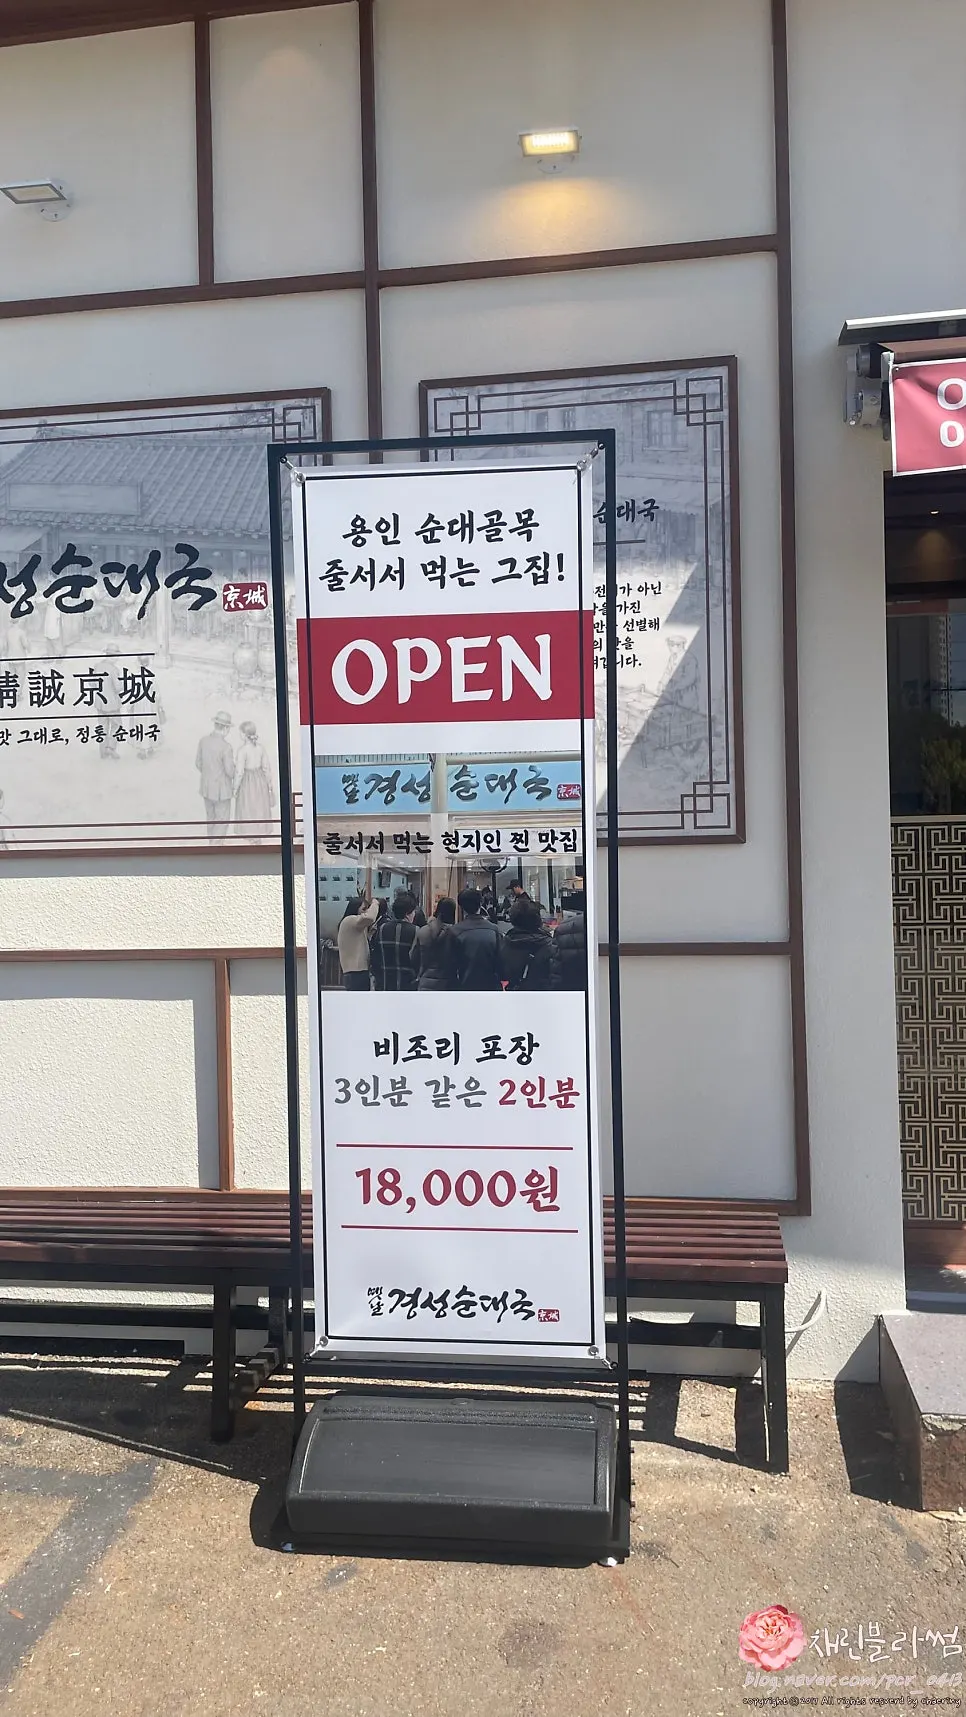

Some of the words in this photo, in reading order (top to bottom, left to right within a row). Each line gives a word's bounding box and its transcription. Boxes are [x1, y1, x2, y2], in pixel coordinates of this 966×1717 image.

[342, 512, 401, 548] 용인
[414, 508, 540, 543] 순대골목
[318, 556, 405, 592] 줄서서
[420, 555, 480, 590] 먹는
[491, 551, 565, 584] 그집!
[223, 583, 268, 612] 京城
[637, 581, 662, 597] 아닌
[616, 600, 641, 615] 가진
[623, 617, 660, 632] 선별해
[331, 633, 552, 706] OPEN
[17, 726, 69, 745] 그대로,
[76, 724, 107, 743] 정통
[112, 723, 160, 742] 순대국
[322, 832, 385, 856] 줄서서
[393, 831, 434, 855] 먹는
[441, 830, 502, 854] 현지인
[510, 830, 530, 853] 찐
[538, 829, 578, 853] 맛집
[373, 1031, 460, 1066] 비조리
[475, 1032, 540, 1066] 포장
[334, 1074, 413, 1107] 3인분
[424, 1075, 487, 1109] 같은
[498, 1076, 581, 1109] 2인분
[355, 1166, 561, 1214] 18,000원
